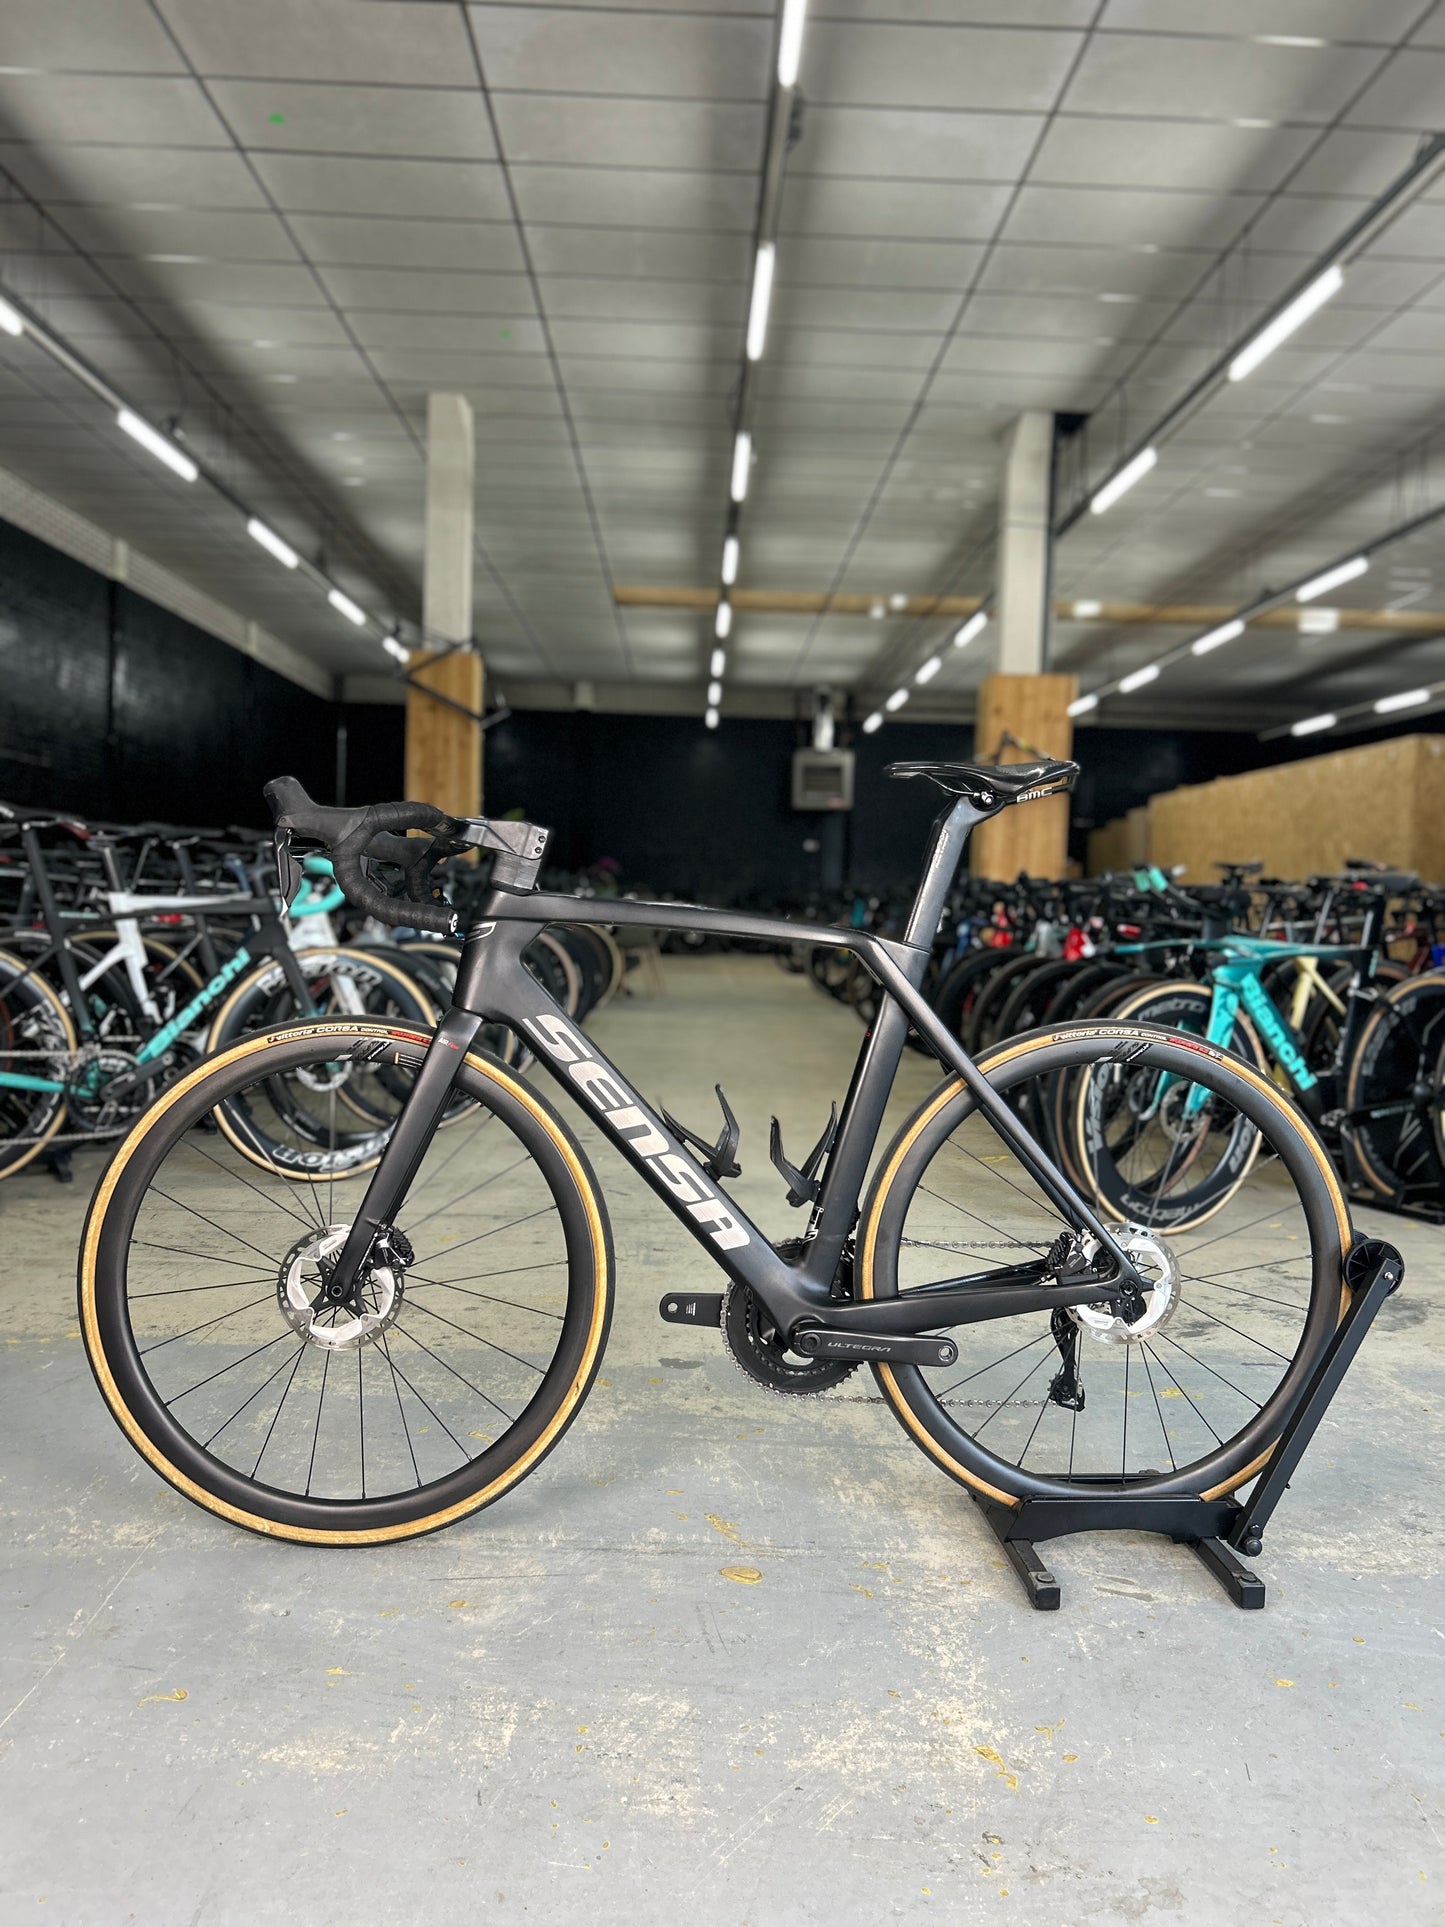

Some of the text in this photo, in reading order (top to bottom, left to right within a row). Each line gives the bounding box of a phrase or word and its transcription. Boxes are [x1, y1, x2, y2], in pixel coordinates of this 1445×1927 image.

[1017, 787, 1053, 803] BMC
[147, 946, 251, 1058] Bianchi
[276, 1028, 313, 1041] vittoria
[1060, 1030, 1096, 1041] vittoria
[1099, 1029, 1139, 1037] CORSA
[1241, 972, 1318, 1092] Bianchi
[827, 1341, 892, 1353] ULTEGRA
